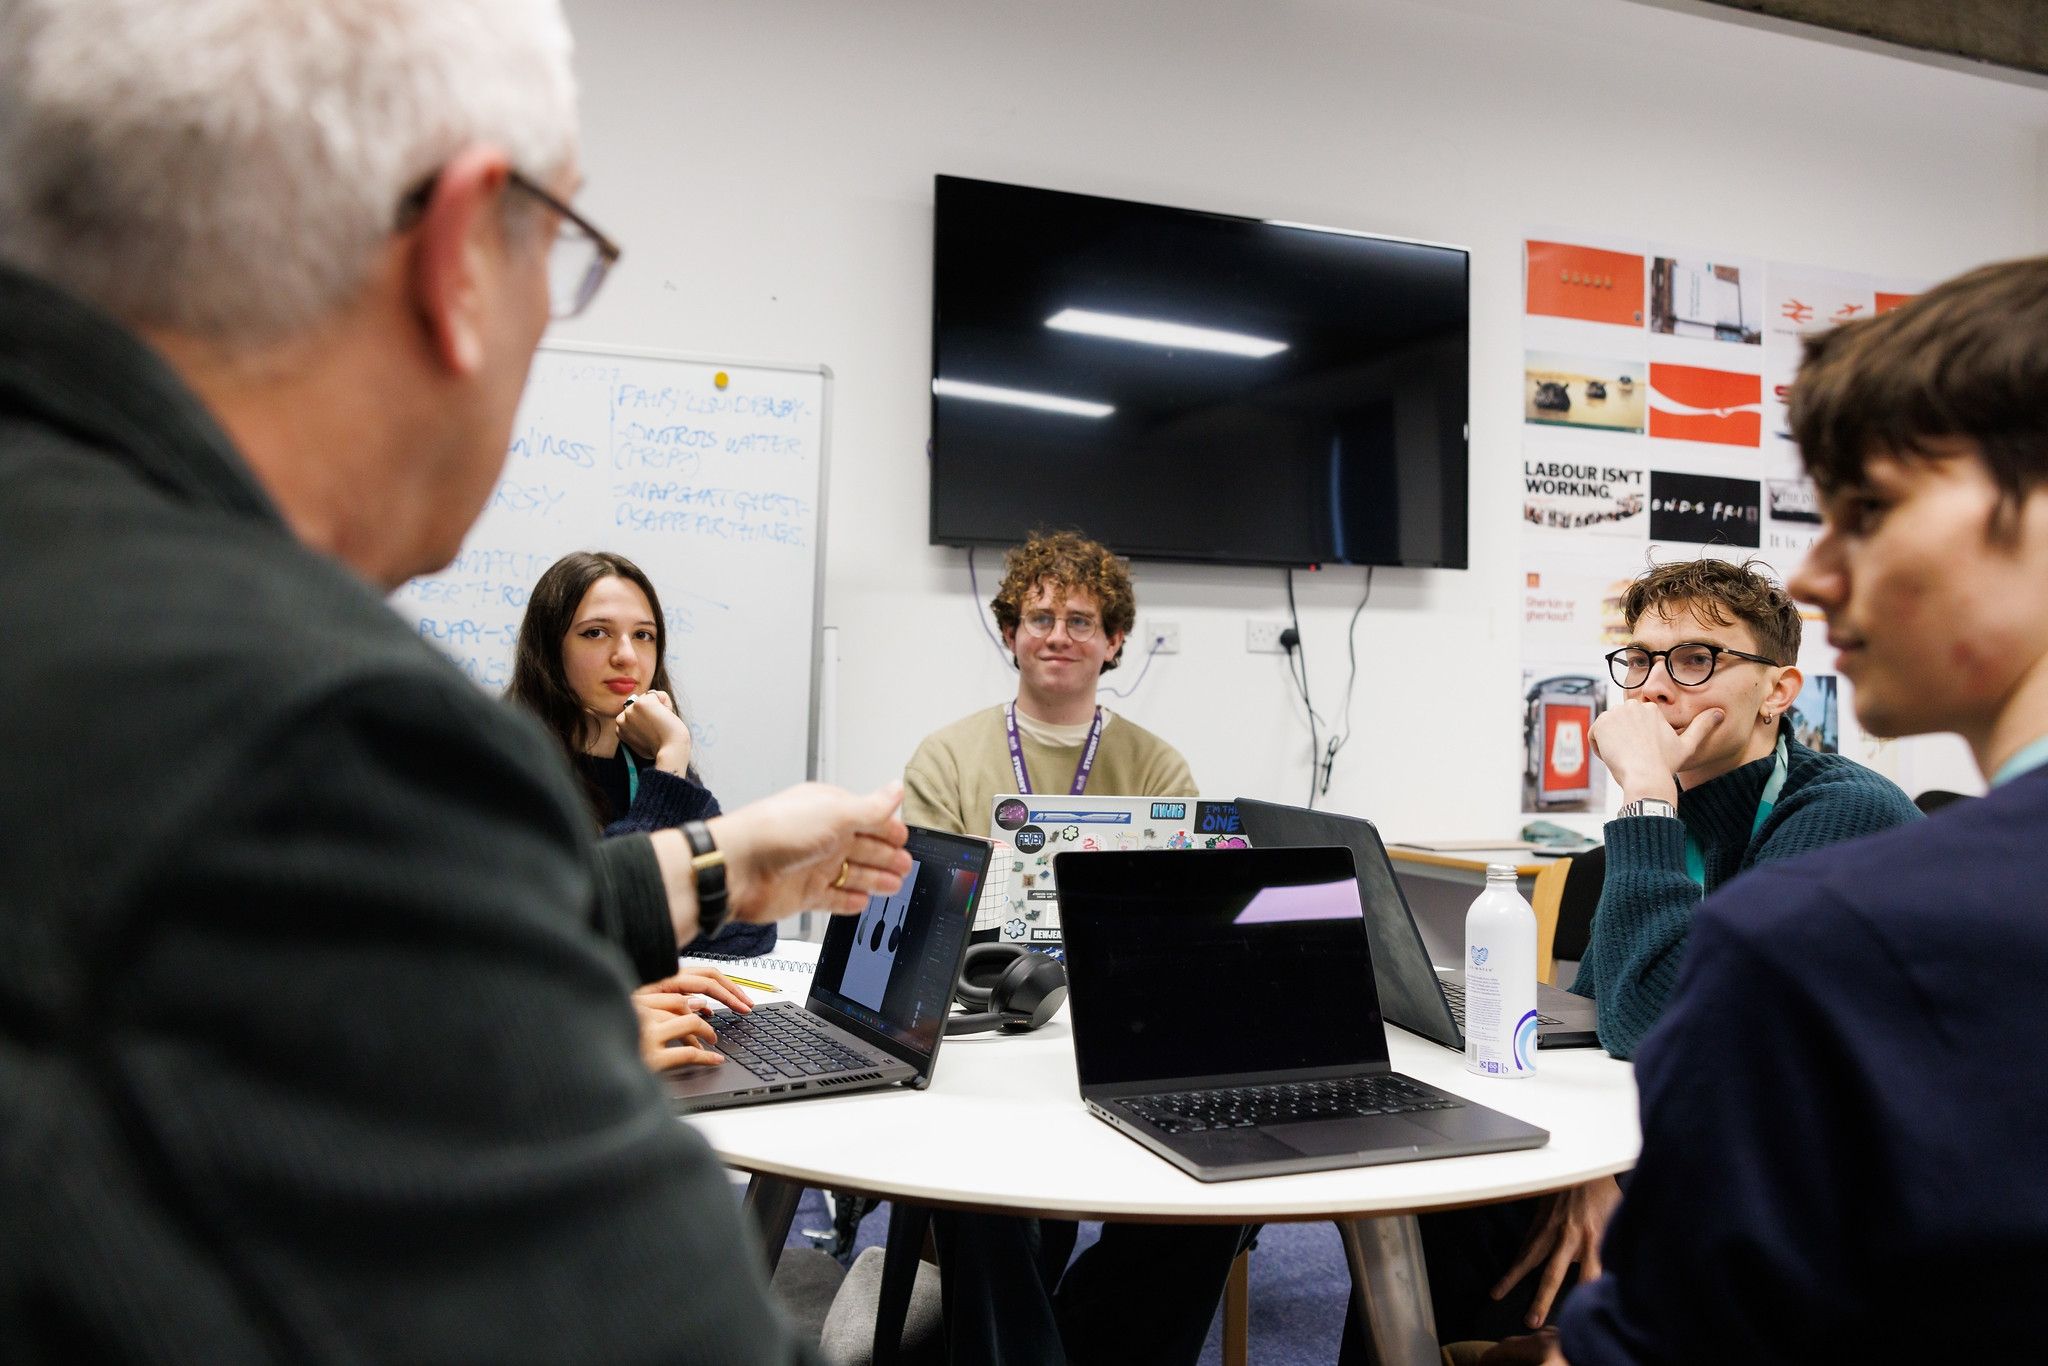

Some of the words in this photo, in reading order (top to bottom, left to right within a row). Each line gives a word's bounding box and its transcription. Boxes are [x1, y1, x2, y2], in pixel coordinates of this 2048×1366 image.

[1525, 461, 1597, 480] LABOUR
[1602, 467, 1643, 484] ISN'T
[1202, 814, 1240, 832] ONE
